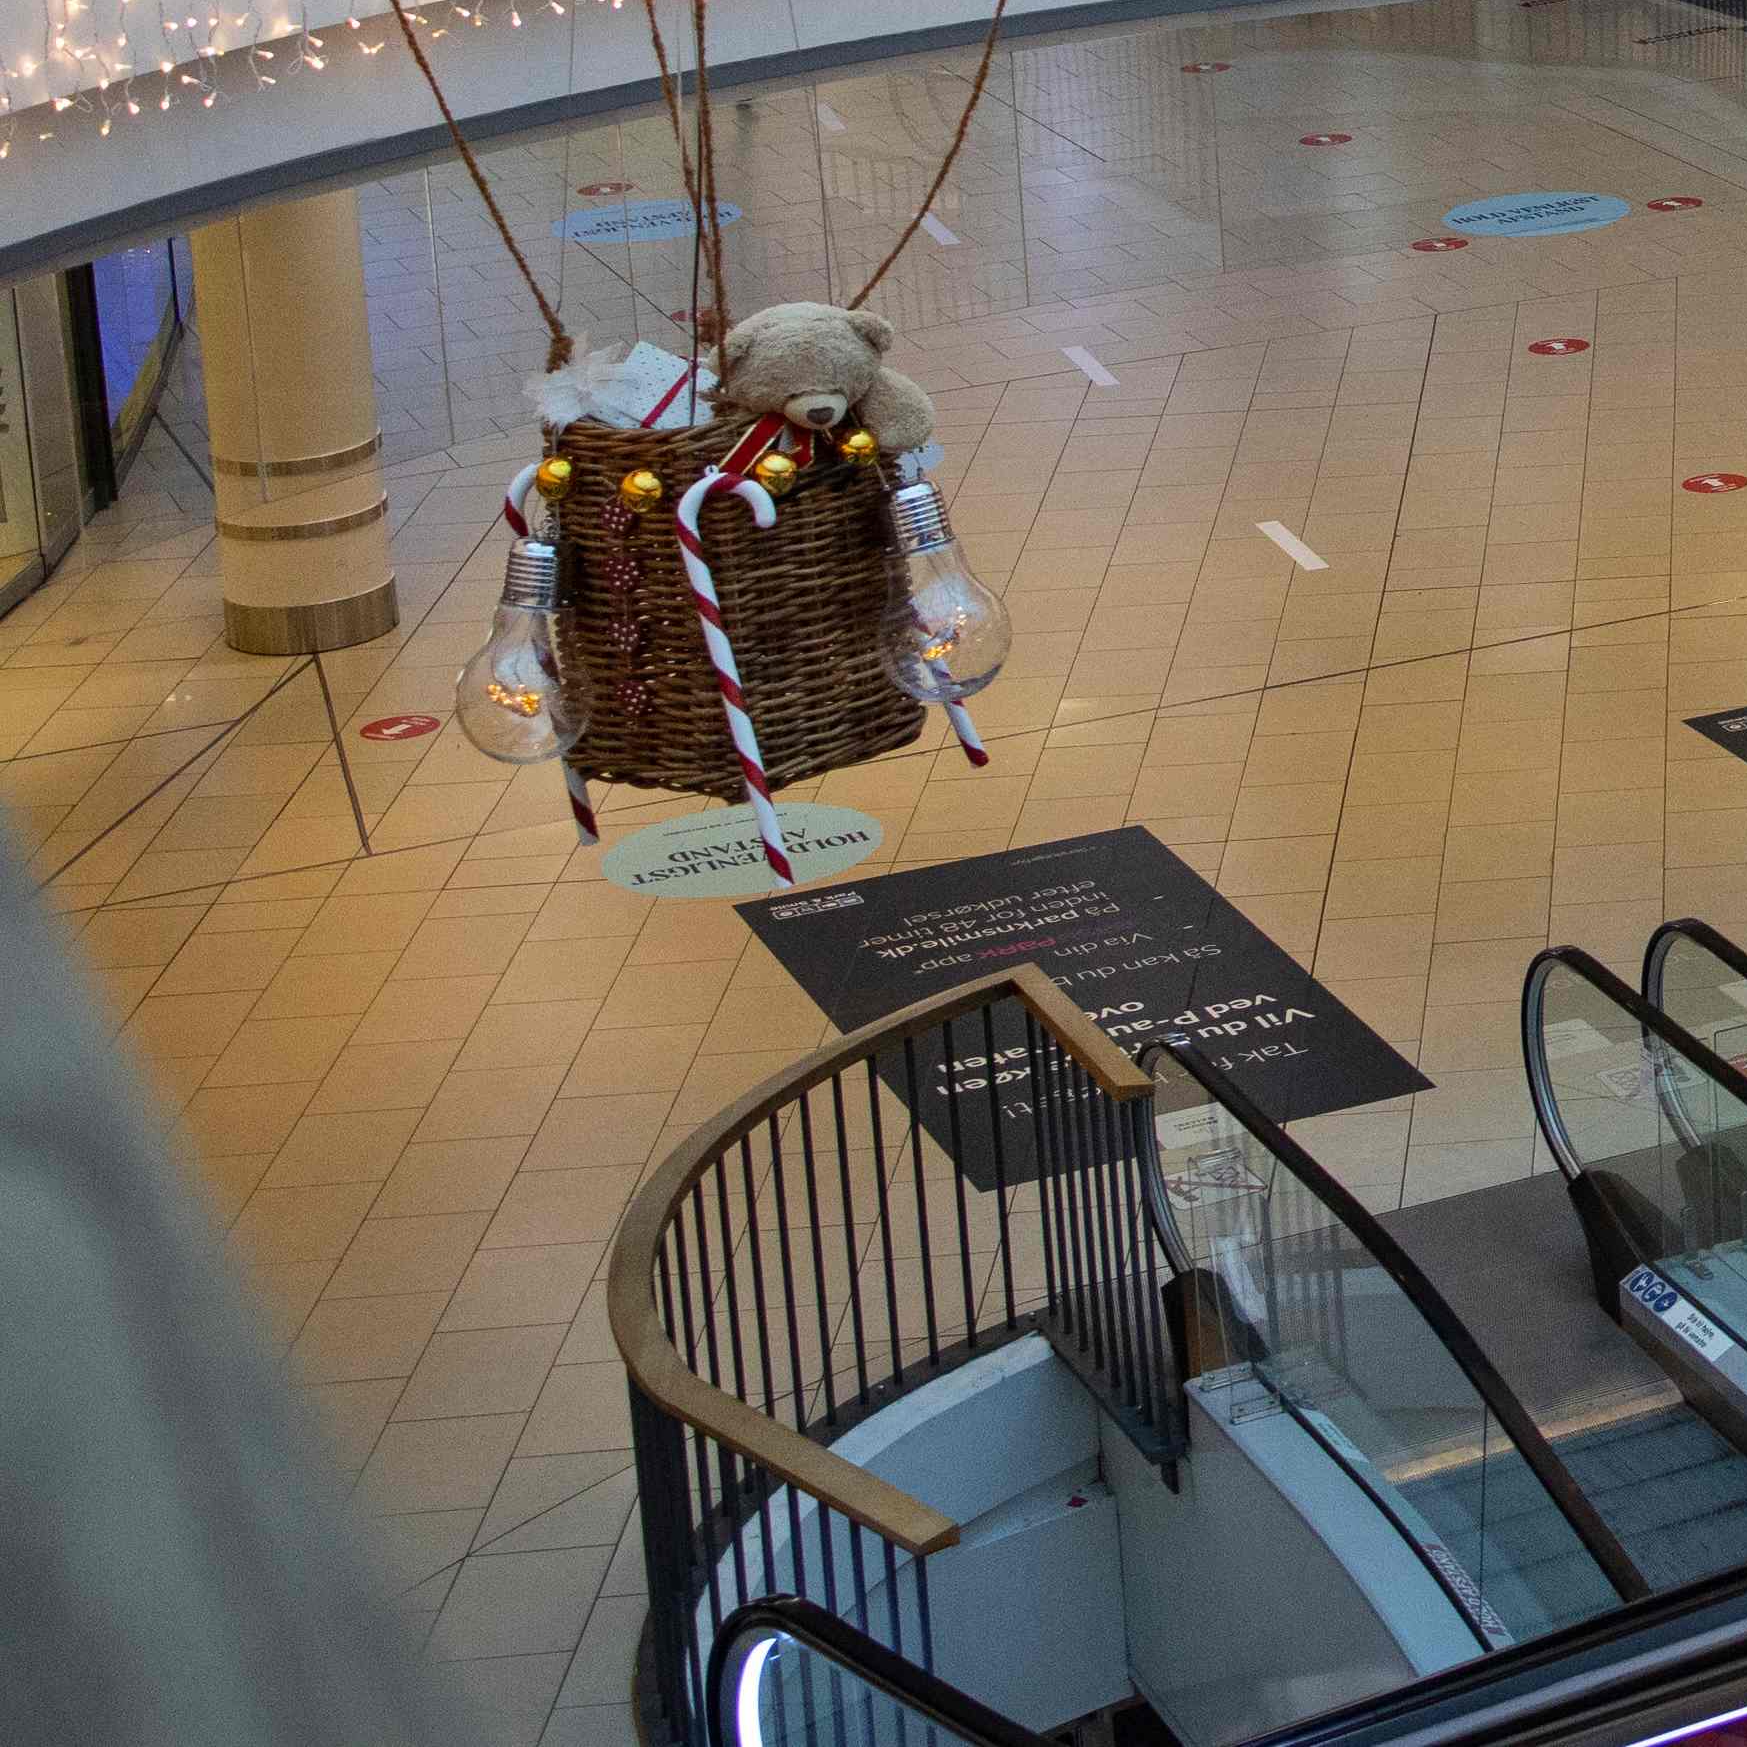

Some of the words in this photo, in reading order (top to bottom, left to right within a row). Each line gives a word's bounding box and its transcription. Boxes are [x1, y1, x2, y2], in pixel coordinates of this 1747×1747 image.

[1030, 879, 1096, 900] efter
[903, 894, 1023, 927] udkørsel
[1029, 890, 1112, 913] inden
[1083, 902, 1122, 917] På
[939, 918, 978, 933] 48
[984, 909, 1027, 924] for
[858, 927, 935, 949] timer
[875, 908, 1081, 959] parknsmile.dk
[1103, 931, 1154, 947] Via
[1053, 940, 1099, 958] din
[1183, 943, 1223, 959] Så
[1121, 951, 1184, 972] kan
[1075, 964, 1117, 982] du
[1203, 992, 1279, 1020] ved
[1253, 1007, 1317, 1030] Vil
[1196, 1019, 1249, 1040] du
[1243, 1041, 1311, 1064] Tak
